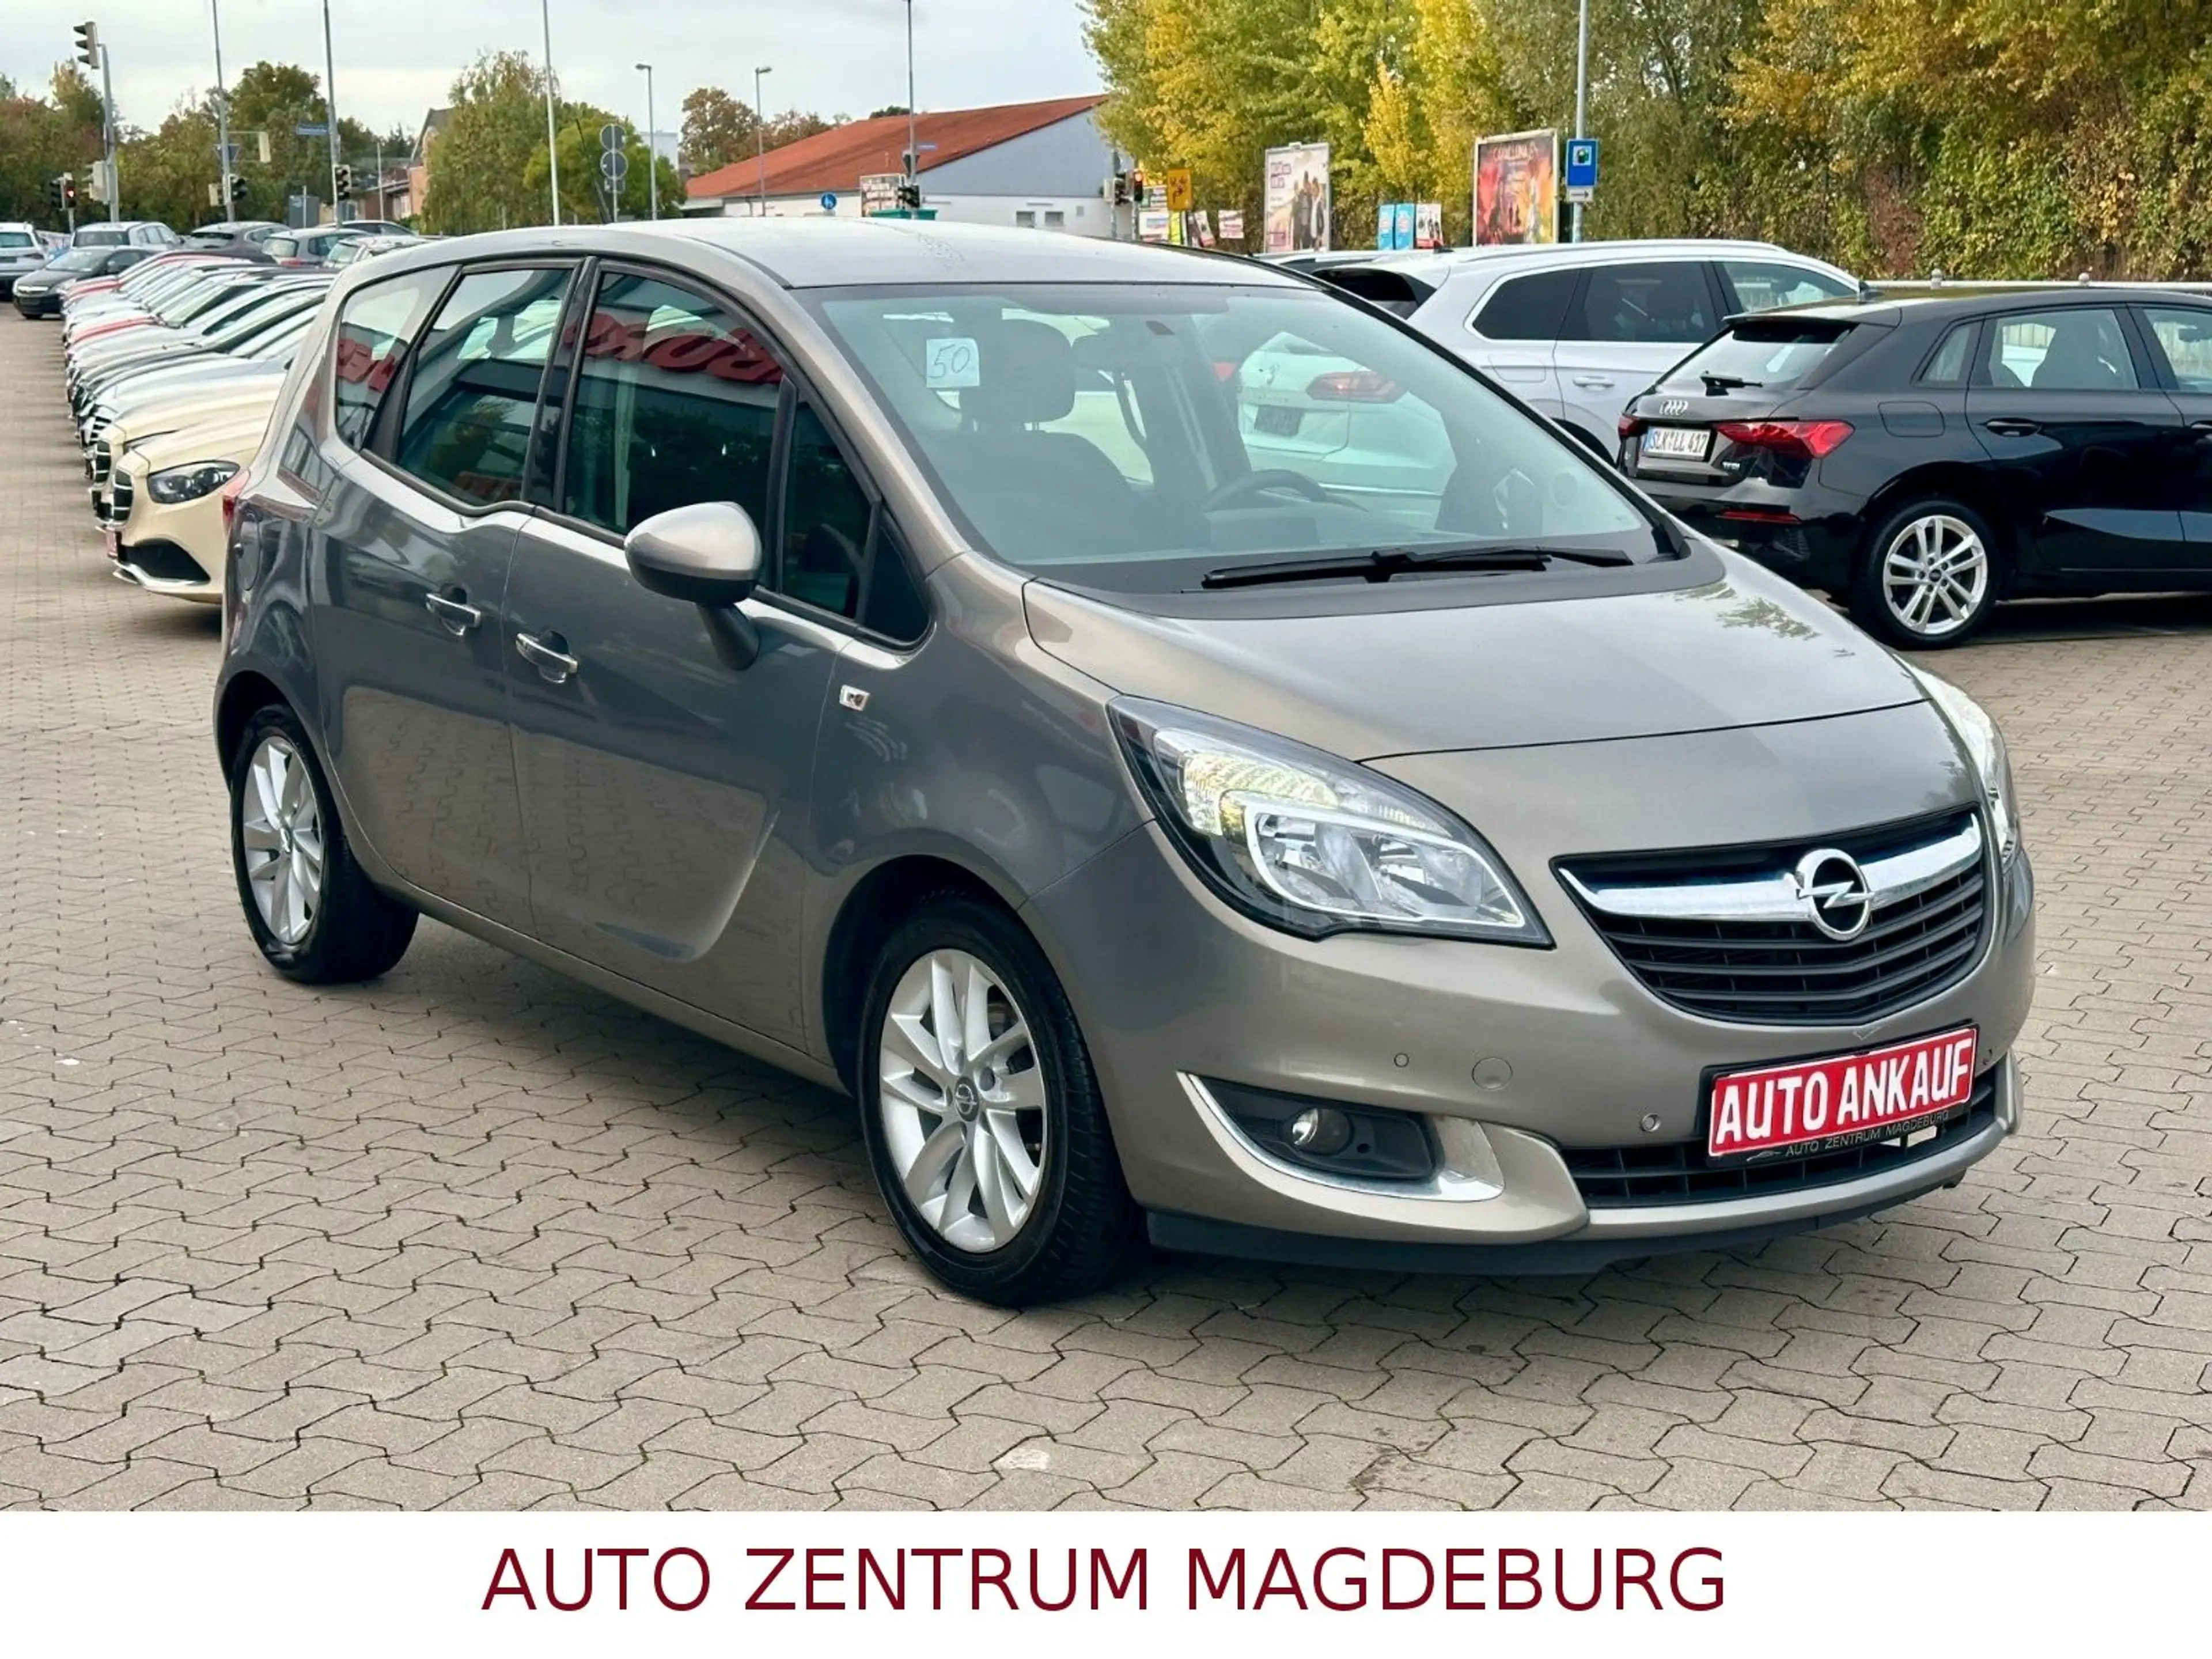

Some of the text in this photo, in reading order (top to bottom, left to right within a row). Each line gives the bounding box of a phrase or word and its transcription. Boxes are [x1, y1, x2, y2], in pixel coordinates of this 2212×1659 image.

[928, 344, 971, 380] 50
[1715, 1037, 1972, 1145] AUTO ANKAUF
[1786, 1110, 1949, 1157] AUTO ZENTRUM MAGDEBURG
